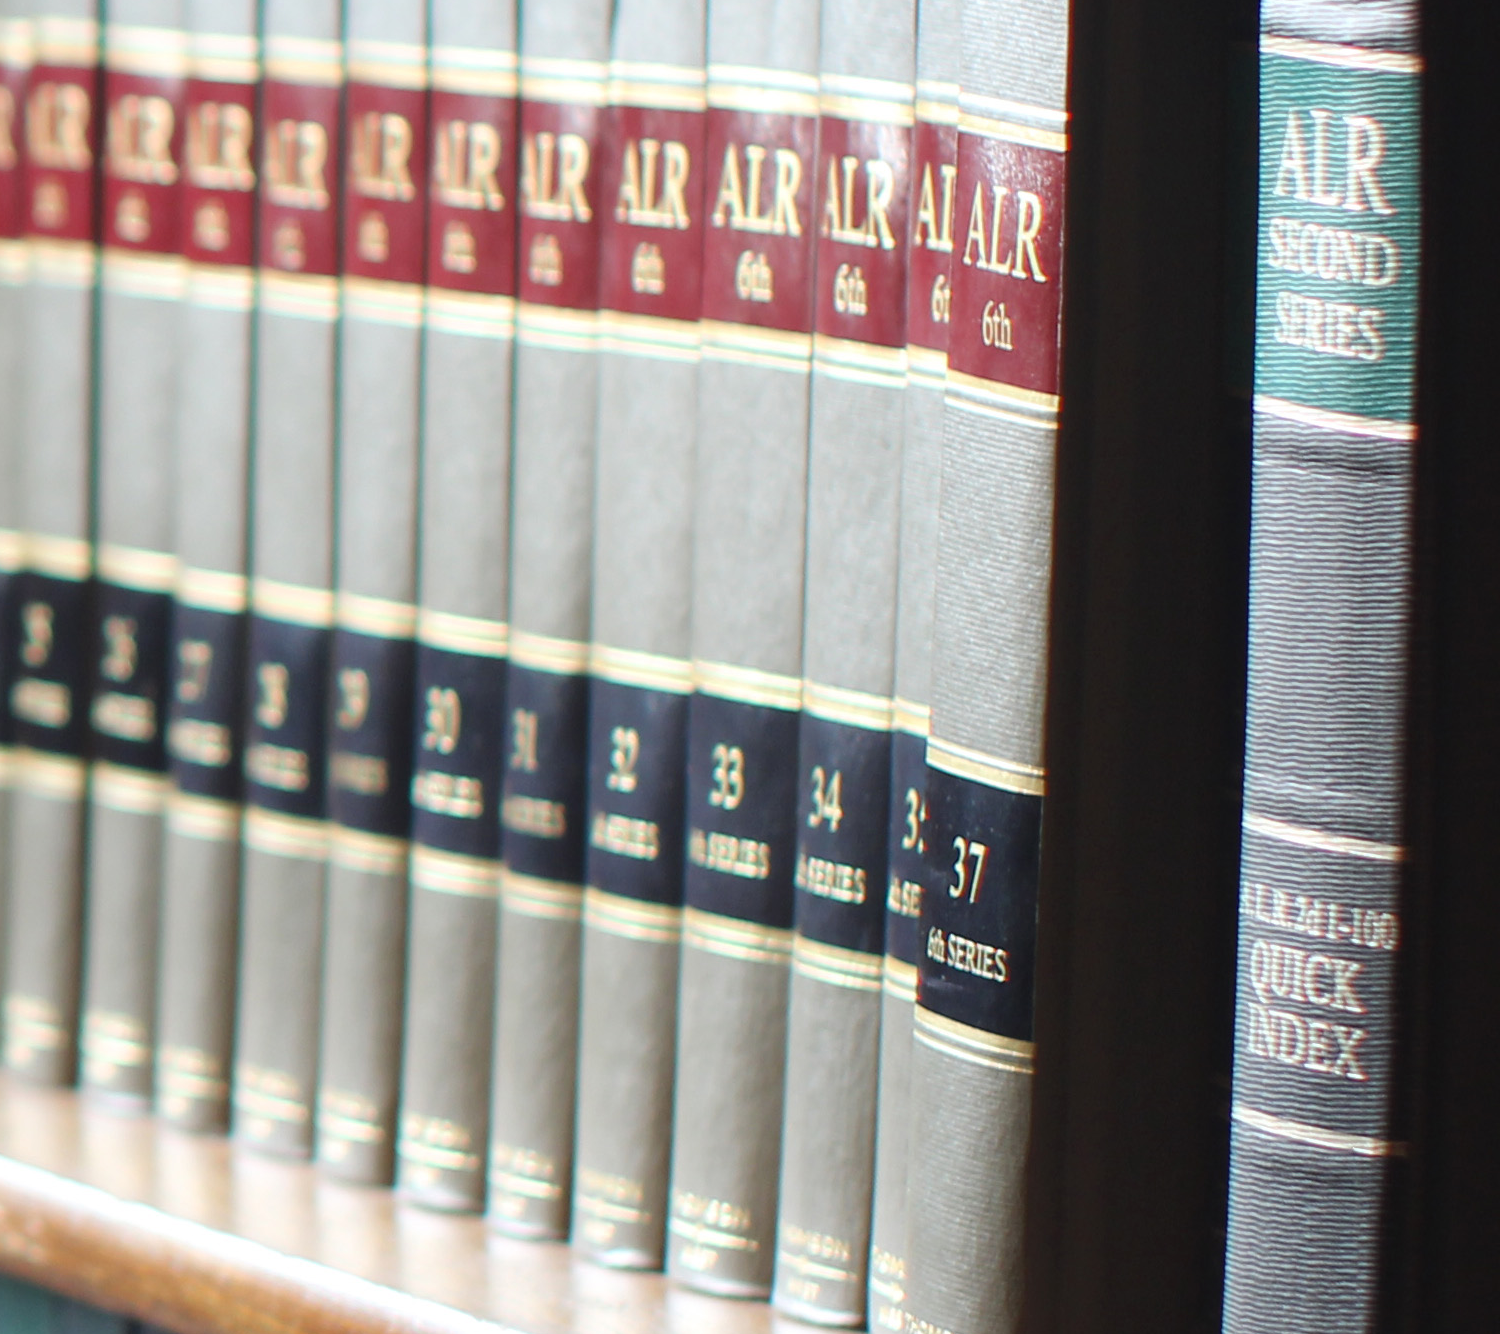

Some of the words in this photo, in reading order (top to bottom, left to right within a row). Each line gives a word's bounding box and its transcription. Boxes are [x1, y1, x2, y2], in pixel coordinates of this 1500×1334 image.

[615, 137, 691, 231] ALR
[712, 142, 803, 238] ALR
[1271, 106, 1398, 216] ALR
[820, 152, 896, 251] ALR
[962, 179, 1049, 284] ALR
[735, 249, 774, 304] 6th
[1268, 216, 1401, 288] SECOND
[834, 262, 868, 317] 6th
[981, 299, 1014, 352] 6th
[1275, 290, 1386, 363] SERIES
[708, 742, 745, 810] 33
[807, 764, 844, 834] 34
[948, 835, 991, 904] 37
[927, 925, 948, 965] 6th
[947, 933, 1010, 983] SERIES
[1250, 938, 1368, 1015] QUICK
[1247, 1002, 1370, 1082] INDEX
